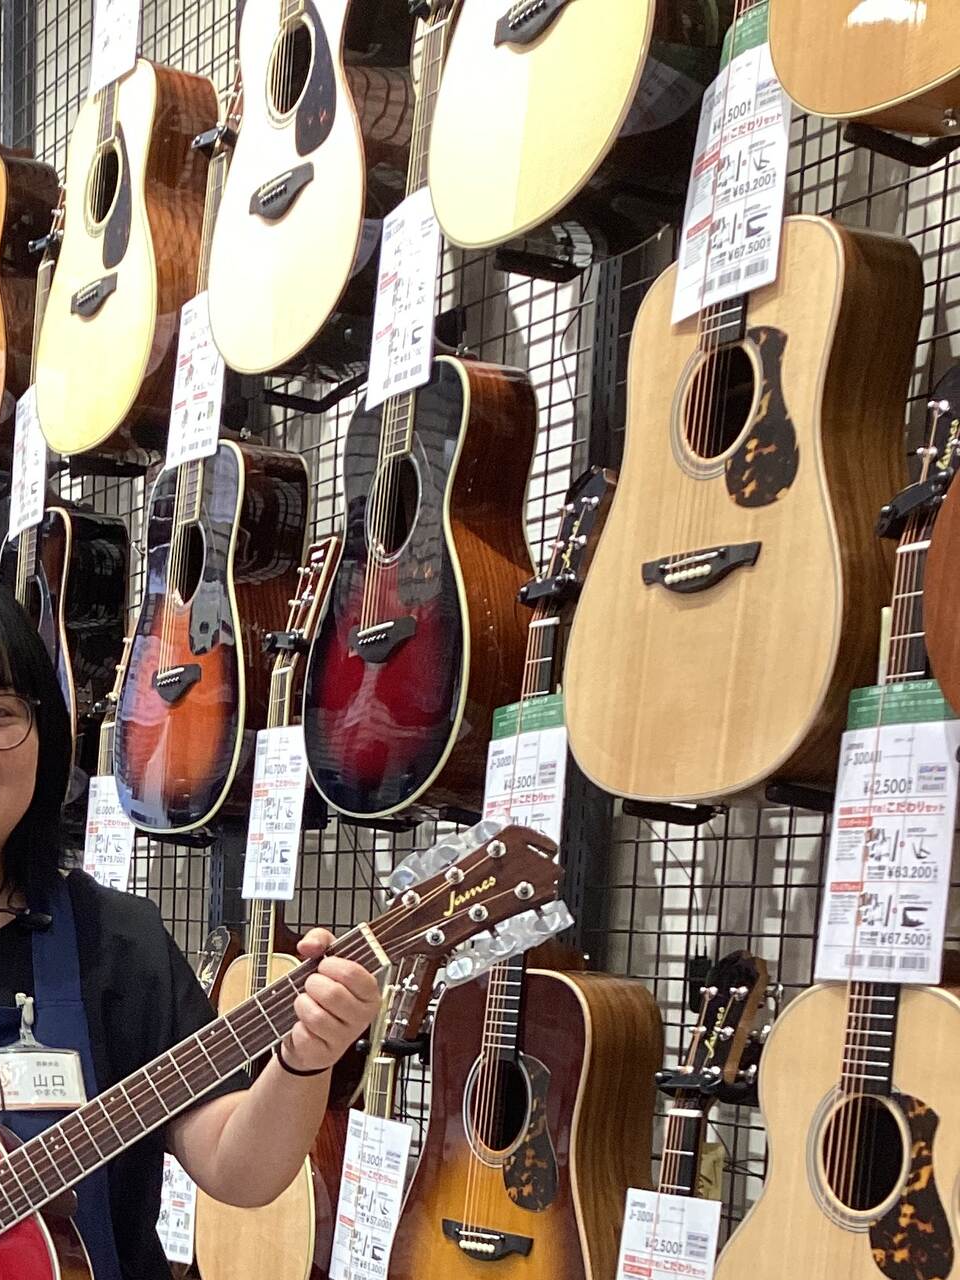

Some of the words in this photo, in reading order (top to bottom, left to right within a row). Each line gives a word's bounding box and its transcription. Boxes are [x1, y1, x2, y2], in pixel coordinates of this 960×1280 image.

[730, 113, 782, 139] こだわりセット
[887, 802, 945, 814] こだわりセット
[888, 865, 932, 879] ¥63,200
[443, 875, 497, 917] James
[880, 931, 926, 946] ¥67,500
[33, 1073, 65, 1088] 山口
[663, 1260, 706, 1275] こだわりセット
